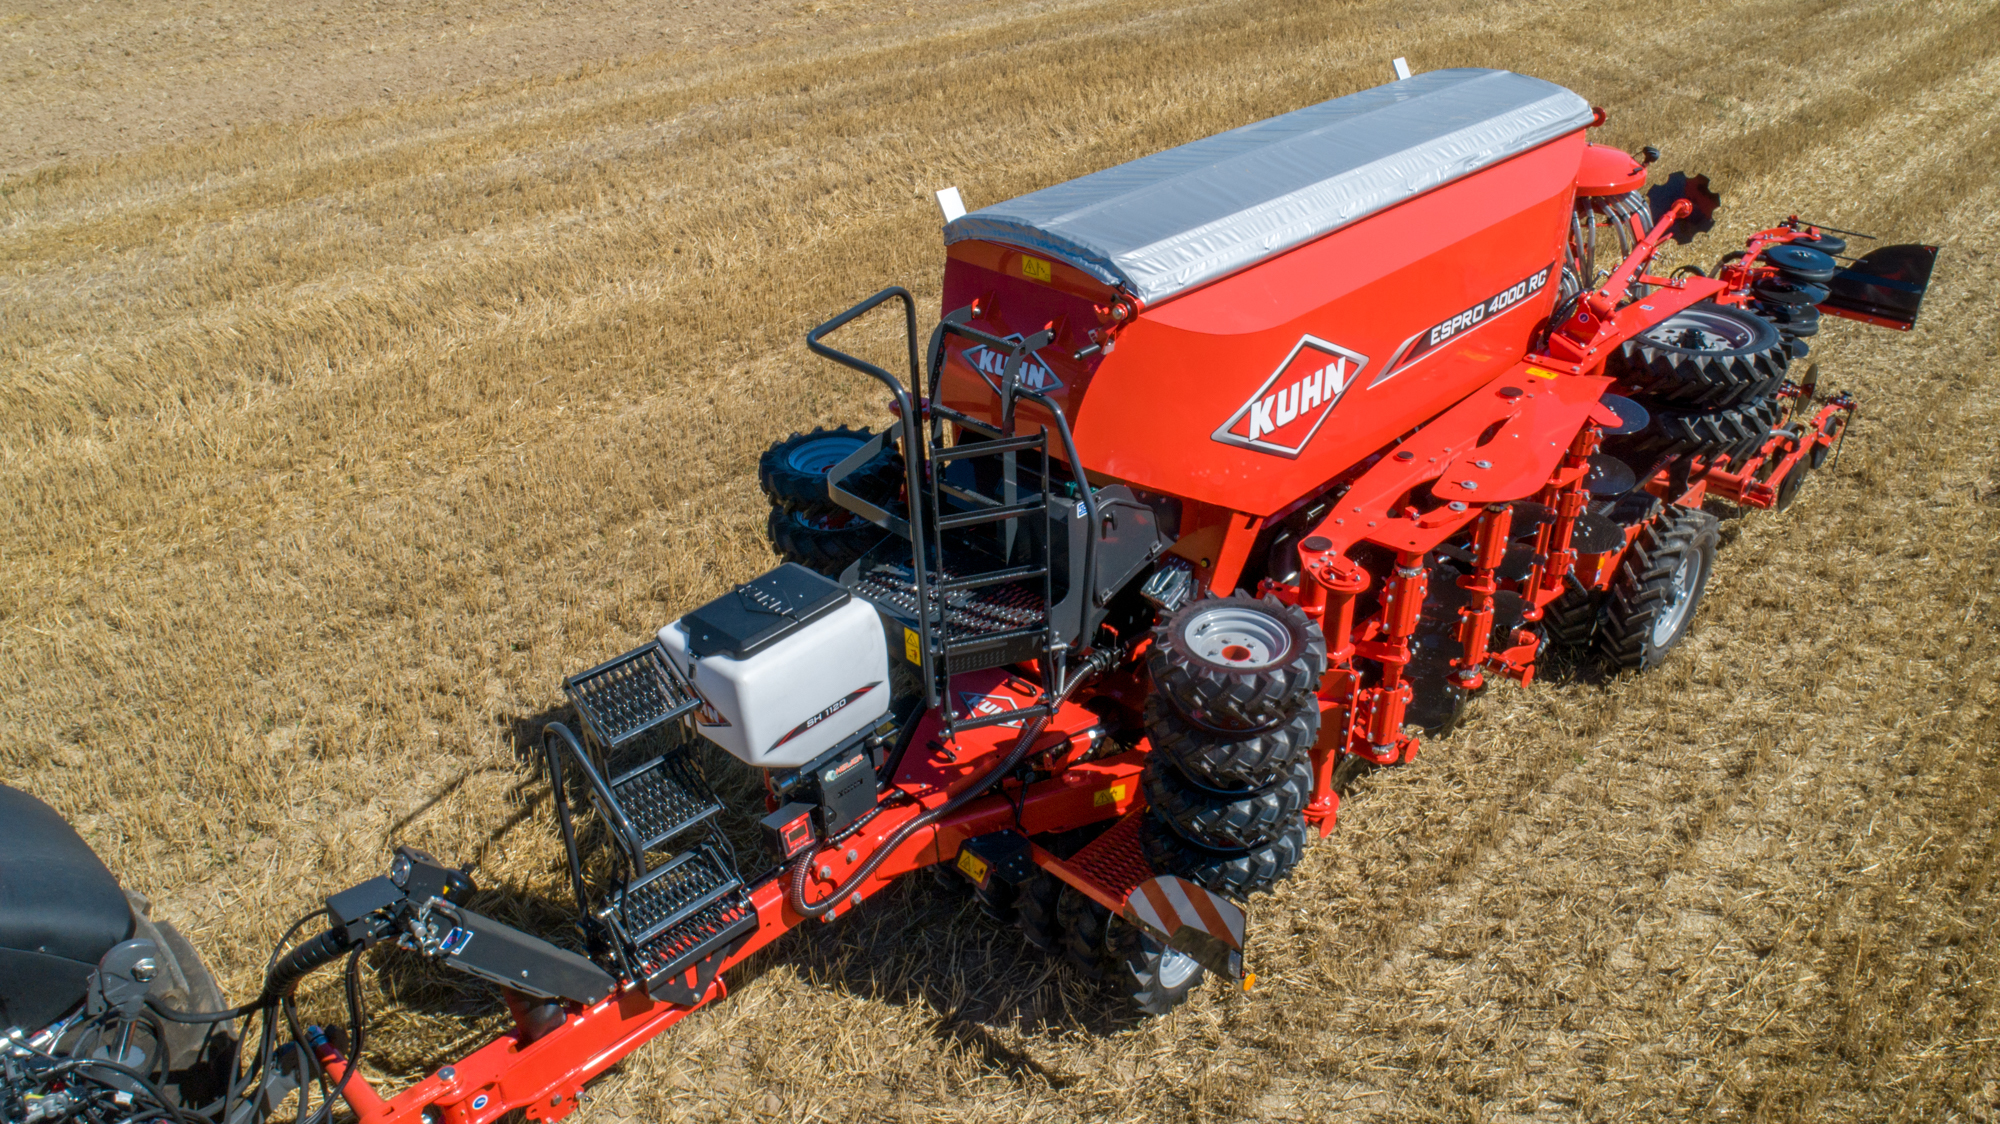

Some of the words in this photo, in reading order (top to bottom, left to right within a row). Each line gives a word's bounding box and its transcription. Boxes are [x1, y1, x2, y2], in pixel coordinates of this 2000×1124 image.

[1430, 303, 1485, 346] ESPRO
[1488, 281, 1526, 313] 4000
[1528, 268, 1547, 293] RC
[1249, 356, 1346, 442] KUHN
[806, 713, 823, 728] SH
[825, 698, 847, 716] 1120
